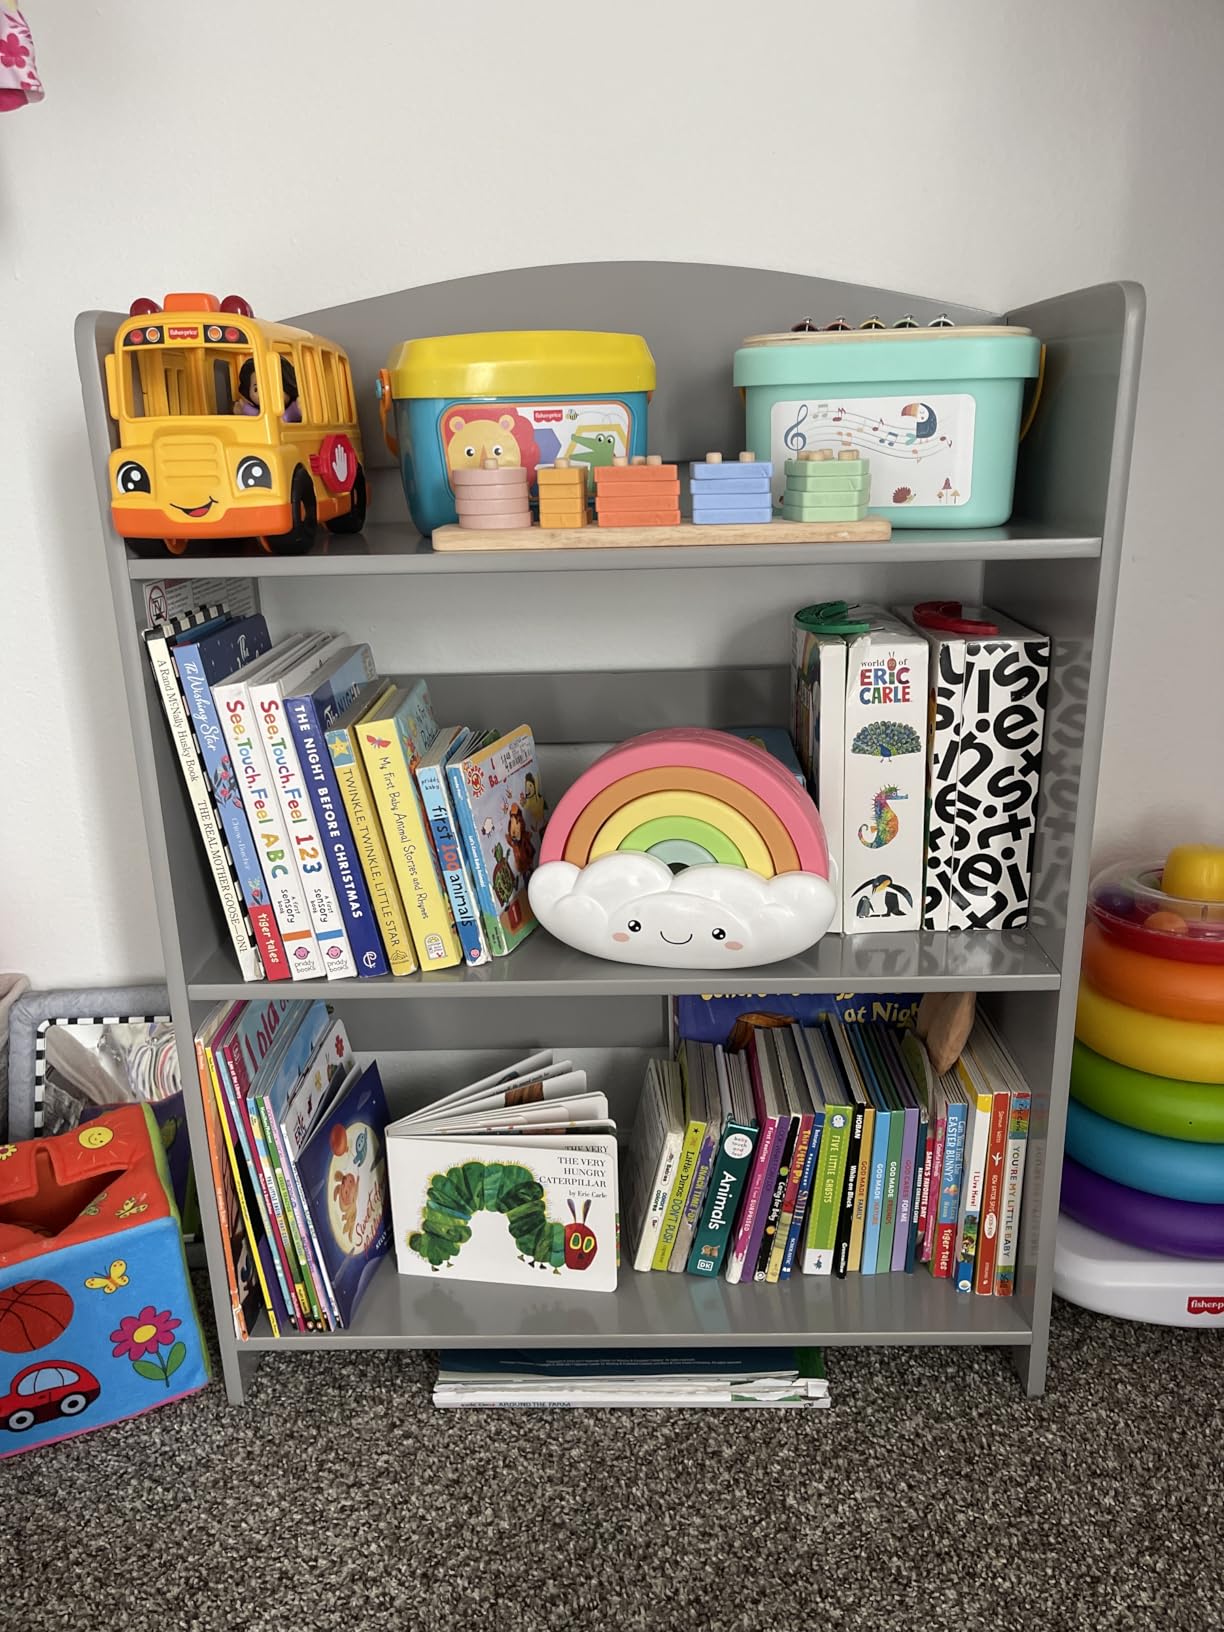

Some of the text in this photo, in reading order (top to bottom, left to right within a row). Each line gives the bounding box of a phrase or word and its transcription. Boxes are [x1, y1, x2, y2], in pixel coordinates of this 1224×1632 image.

[861, 659, 885, 667] world
[860, 667, 910, 686] ERIC
[182, 660, 223, 753] The Wishing Star
[860, 686, 911, 705] CARLE
[157, 658, 198, 782] A Rand McNally Husky Book
[196, 799, 210, 820] THE
[250, 786, 274, 824] Feel
[283, 786, 309, 825] Feel
[293, 704, 364, 919] THE NIGHT BEFORE CHRISTMAS
[203, 821, 218, 848] REAL
[376, 755, 433, 920] My First Baby Animal Stories and Rhymes
[260, 829, 290, 879] ABC
[293, 830, 323, 876] 123
[341, 768, 367, 825] TWINKLE,
[357, 825, 383, 881] TWINKLE,
[374, 881, 393, 918] LITTLE
[384, 918, 401, 947] STAR
[210, 848, 229, 890] MOTHER
[431, 804, 475, 928] first 100 animals
[276, 899, 285, 914] book
[278, 888, 297, 923] sensory
[309, 899, 318, 914] book
[311, 887, 330, 923] sensory
[256, 912, 281, 963] tiger tales
[844, 1002, 920, 1028] at Nig
[853, 1114, 862, 1139] HOBAN
[759, 1139, 770, 1163] Feelings
[794, 1144, 807, 1169] Little
[943, 1116, 958, 1181] EASTER BUNNY?
[558, 1156, 606, 1167] THE VERY
[564, 1167, 606, 1177] HUNGRY
[681, 1150, 694, 1173] Little
[823, 1135, 840, 1203] FIVE LITTLE GHOSTS
[848, 1164, 856, 1182] White
[924, 1150, 932, 1176] SANTA'S
[539, 1176, 607, 1188] CATERPILLAR
[674, 1173, 688, 1198] Dinos
[685, 1165, 708, 1224] SNACK TIME FOR
[873, 1179, 881, 1199] MADE
[886, 1177, 895, 1197] MADE
[901, 1176, 910, 1197] CARES
[921, 1177, 929, 1204] FAVORITE
[707, 1170, 737, 1232] Animals
[767, 1180, 785, 1222] Caring for Baby
[791, 1189, 808, 1226] SMILE!
[845, 1190, 854, 1208] Black
[855, 1198, 863, 1220] FAMILY
[969, 1189, 978, 1206] Here!
[1002, 1146, 1020, 1257] YOU'RE MY LITTLE BABY
[667, 1198, 682, 1223] DON'T
[743, 1198, 756, 1231] SURPRISED
[899, 1212, 906, 1222] ME
[662, 1224, 675, 1244] PUSH
[941, 1228, 953, 1249] tiger
[785, 1237, 795, 1264] SCHOLASTIC
[939, 1250, 950, 1270] tales
[697, 1260, 712, 1270] DK
